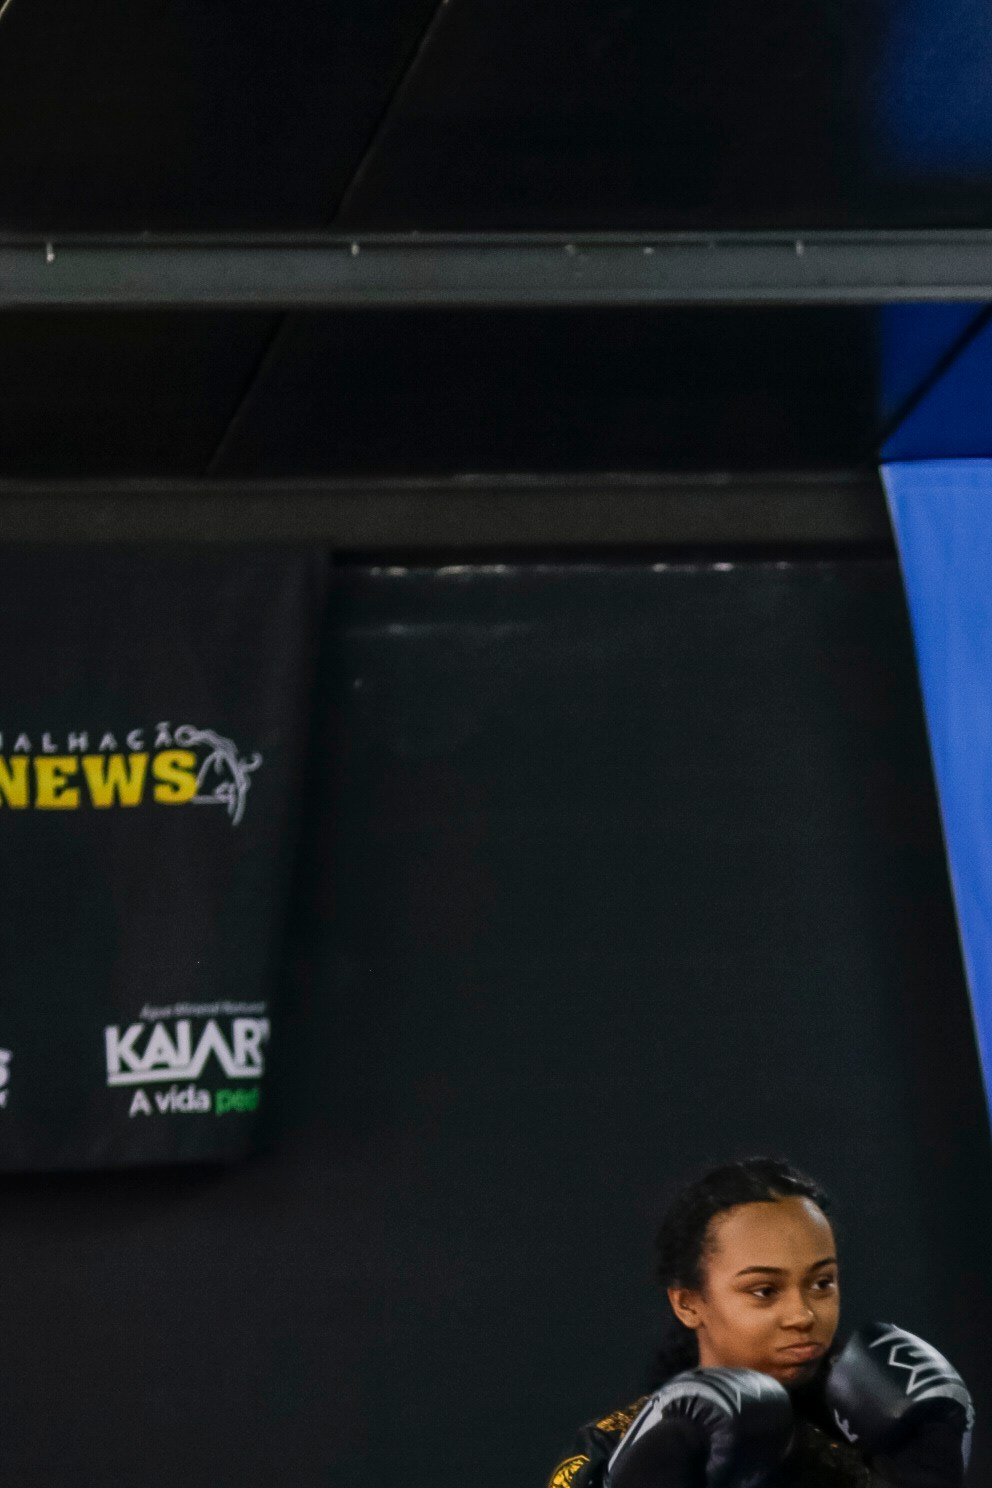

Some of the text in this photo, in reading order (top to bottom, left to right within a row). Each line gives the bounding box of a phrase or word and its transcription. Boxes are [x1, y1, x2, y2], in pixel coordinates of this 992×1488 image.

[105, 1017, 270, 1086] KAIAR
[129, 1088, 152, 1118] A
[154, 1083, 212, 1115] vida
